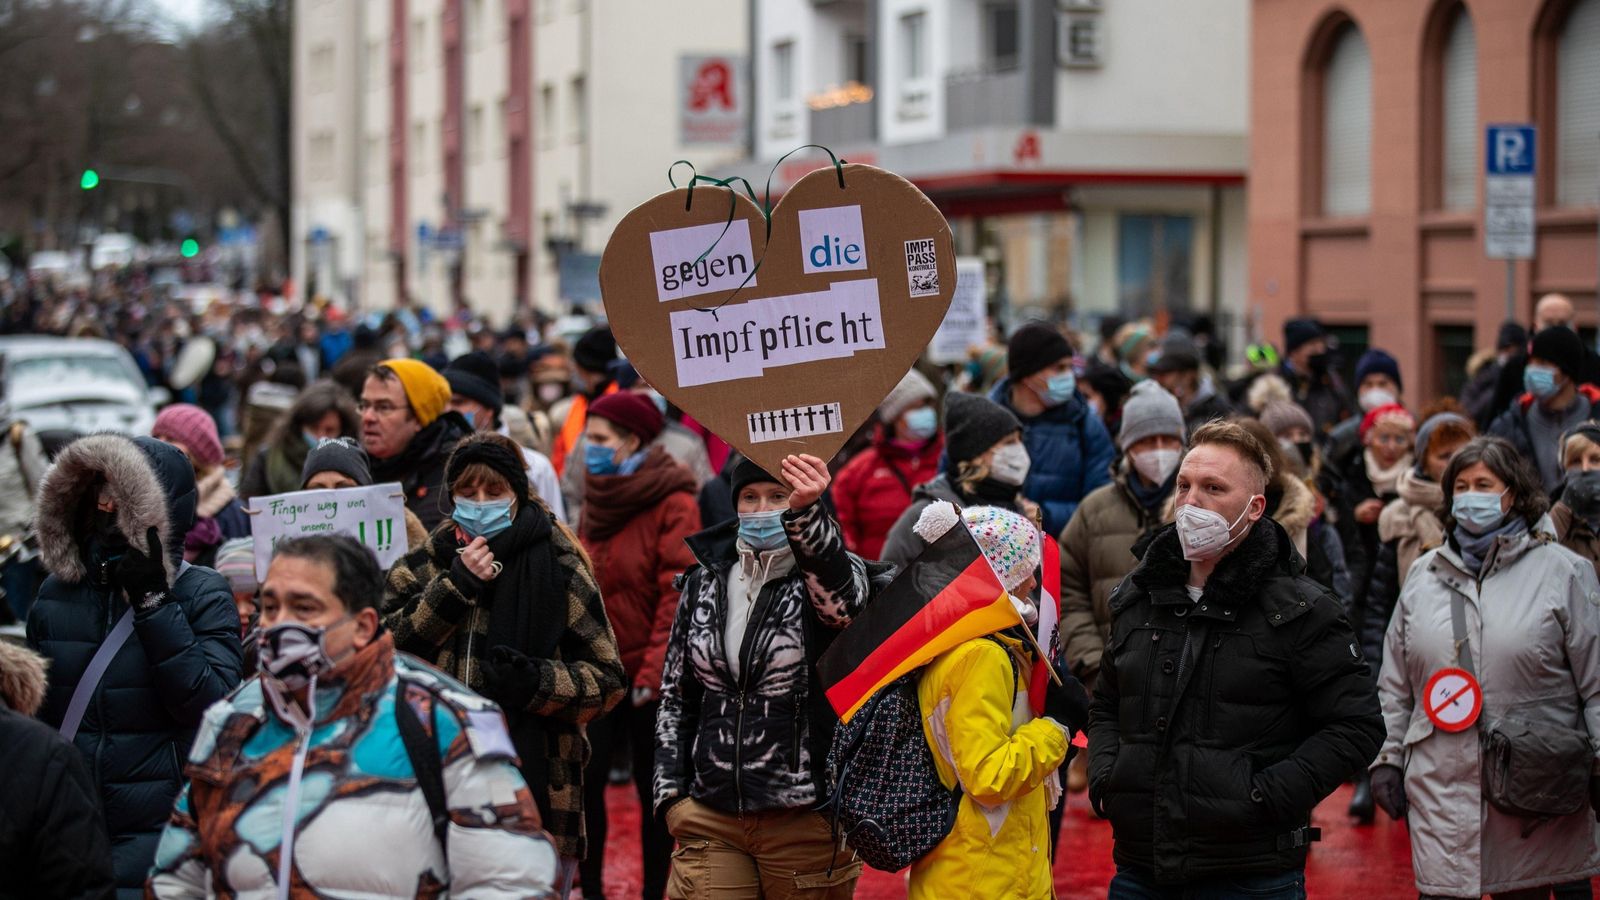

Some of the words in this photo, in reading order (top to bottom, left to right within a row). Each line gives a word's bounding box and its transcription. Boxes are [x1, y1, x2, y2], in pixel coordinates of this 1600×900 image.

[906, 240, 934, 254] IMPF
[662, 253, 747, 291] gegen
[809, 234, 862, 268] die
[907, 252, 936, 265] PASS
[908, 263, 936, 272] KONTROLLE
[269, 499, 309, 525] Finger
[317, 501, 338, 520] weg
[347, 498, 366, 509] von
